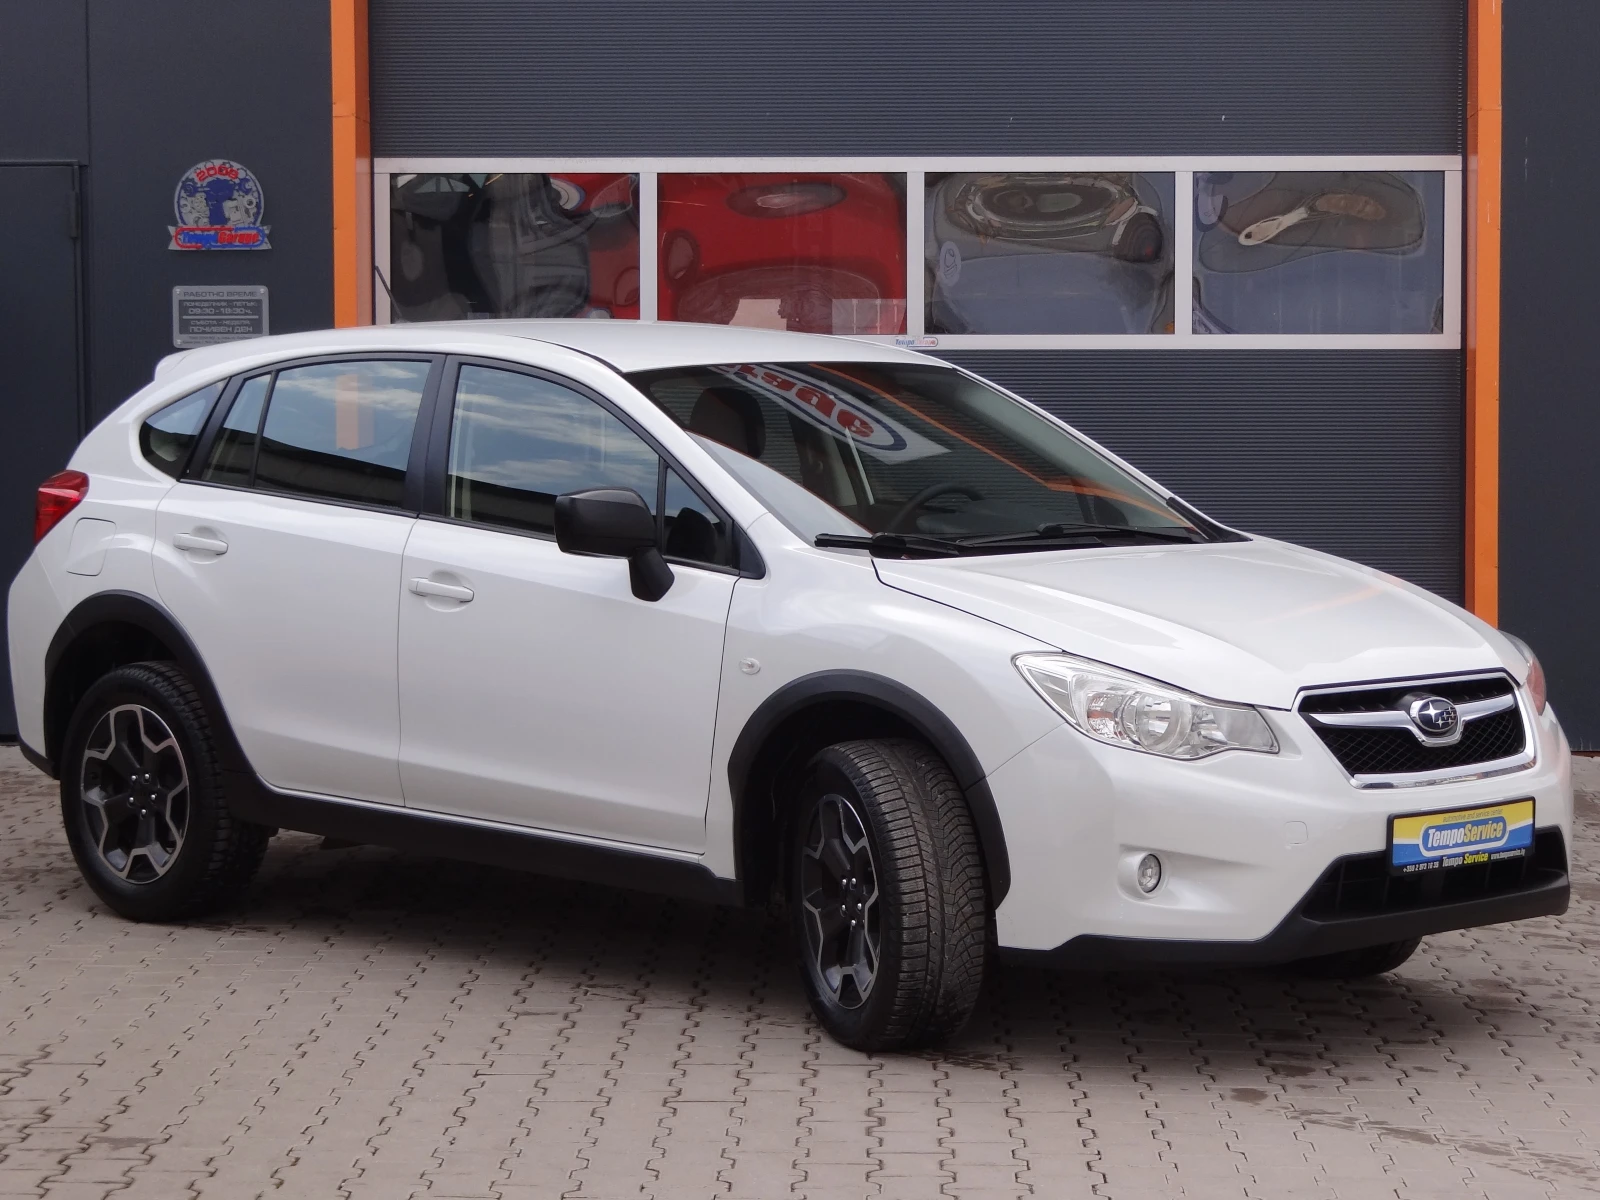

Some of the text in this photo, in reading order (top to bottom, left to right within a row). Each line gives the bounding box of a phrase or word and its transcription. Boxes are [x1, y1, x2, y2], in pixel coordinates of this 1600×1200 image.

[1427, 820, 1504, 848] TempoService
[1442, 855, 1464, 868] Tempo
[1463, 851, 1489, 864] Service
